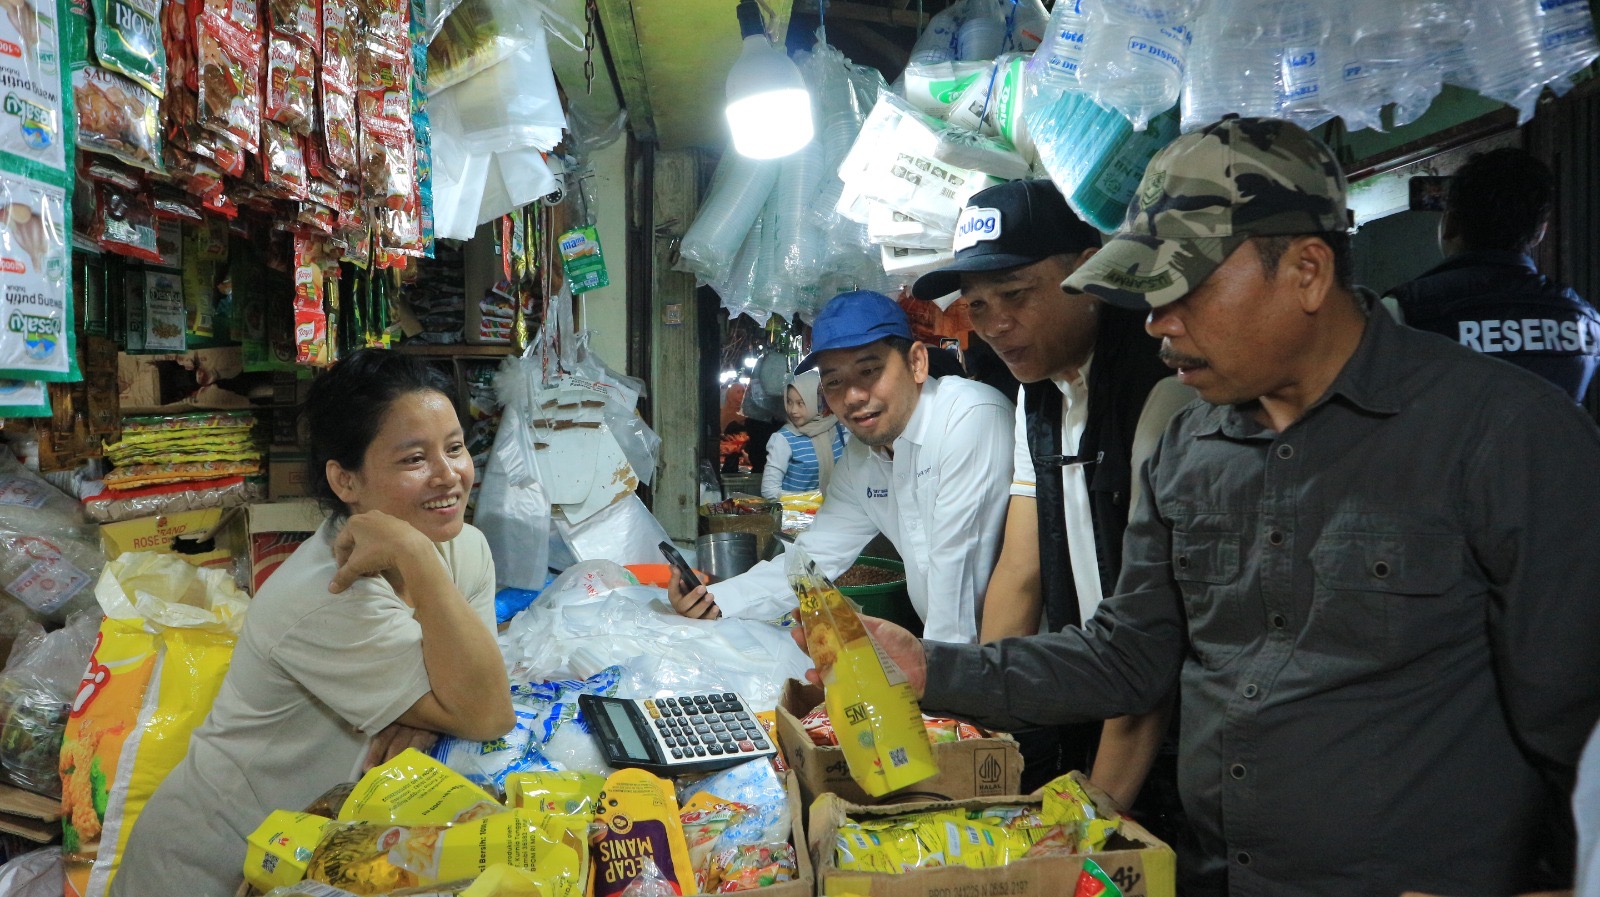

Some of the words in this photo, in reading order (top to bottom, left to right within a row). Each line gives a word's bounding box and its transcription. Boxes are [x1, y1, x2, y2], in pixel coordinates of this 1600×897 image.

[116, 2, 156, 44] SAORI
[272, 46, 295, 63] Royco
[1131, 41, 1147, 50] PP
[1062, 61, 1079, 71] DIS
[4, 92, 55, 123] esaku
[563, 236, 586, 250] mama
[5, 291, 38, 304] putih
[9, 308, 62, 340] Desaku
[1458, 319, 1595, 353] RESERSE
[133, 537, 160, 550] ROSE
[844, 704, 867, 725] SNI
[600, 836, 653, 862] MANIS
[478, 865, 486, 873] si
[606, 856, 653, 883] ECAP
